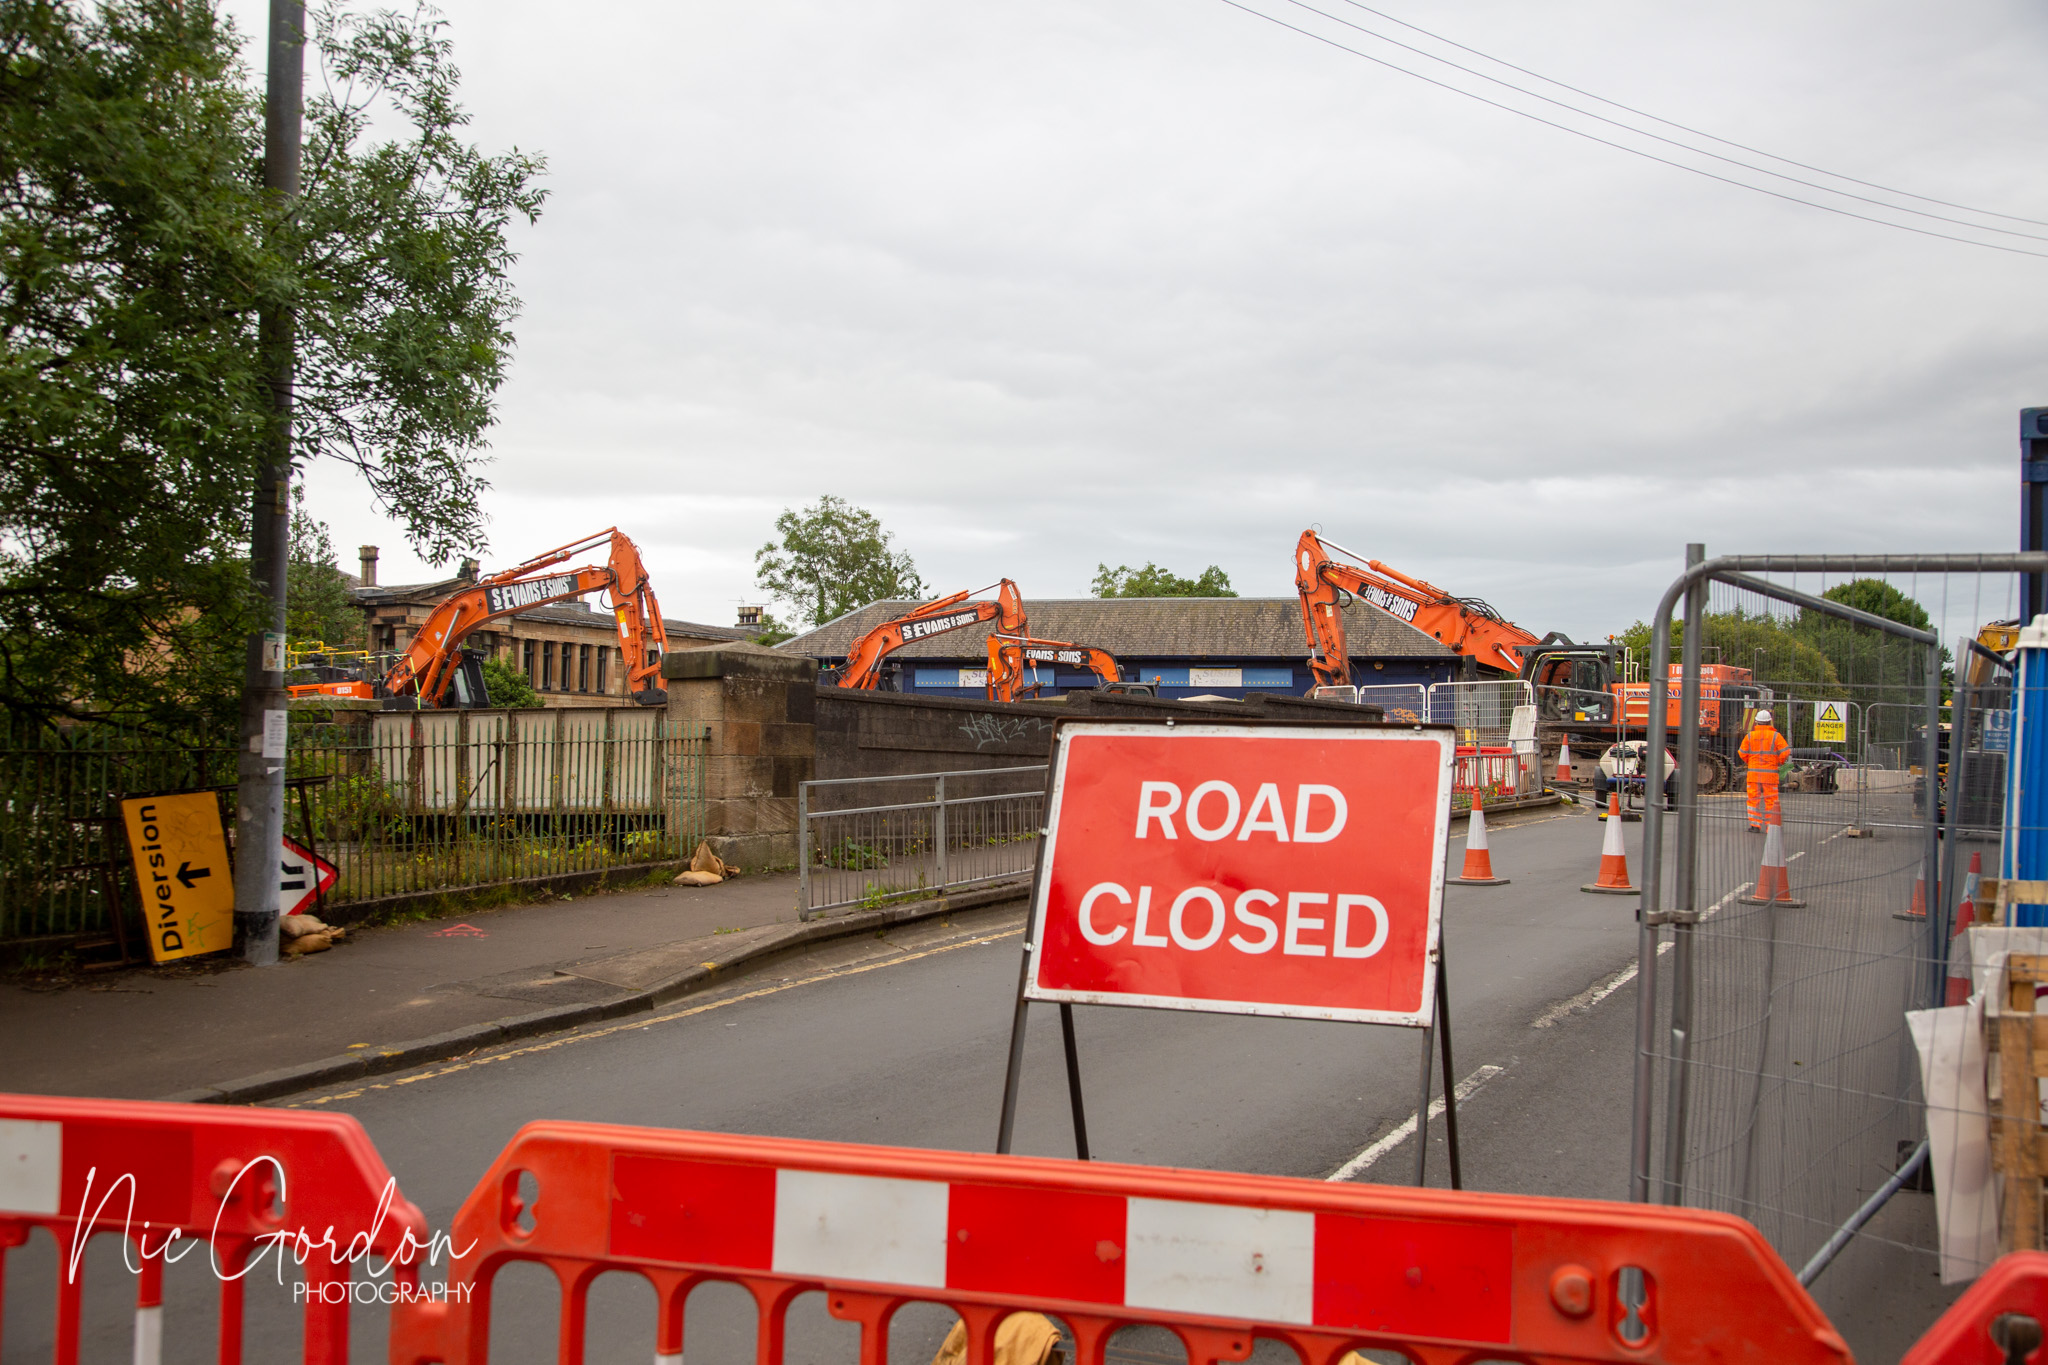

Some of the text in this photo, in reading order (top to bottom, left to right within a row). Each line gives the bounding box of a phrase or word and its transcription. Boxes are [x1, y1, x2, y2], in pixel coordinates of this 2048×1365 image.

[491, 576, 570, 611] S EVANS & SONS
[1367, 585, 1389, 607] EVANS
[1389, 595, 1418, 622] SONS
[902, 625, 913, 640] S
[913, 617, 951, 638] EVANS
[956, 612, 975, 626] SONS
[1026, 649, 1055, 661] EVANS
[1057, 650, 1082, 664] SONS
[1665, 688, 1682, 698] SO
[1702, 689, 1720, 699] TD
[1135, 780, 1348, 843] ROAD
[139, 805, 184, 952] Diversion
[1078, 882, 1390, 959] CLOSED
